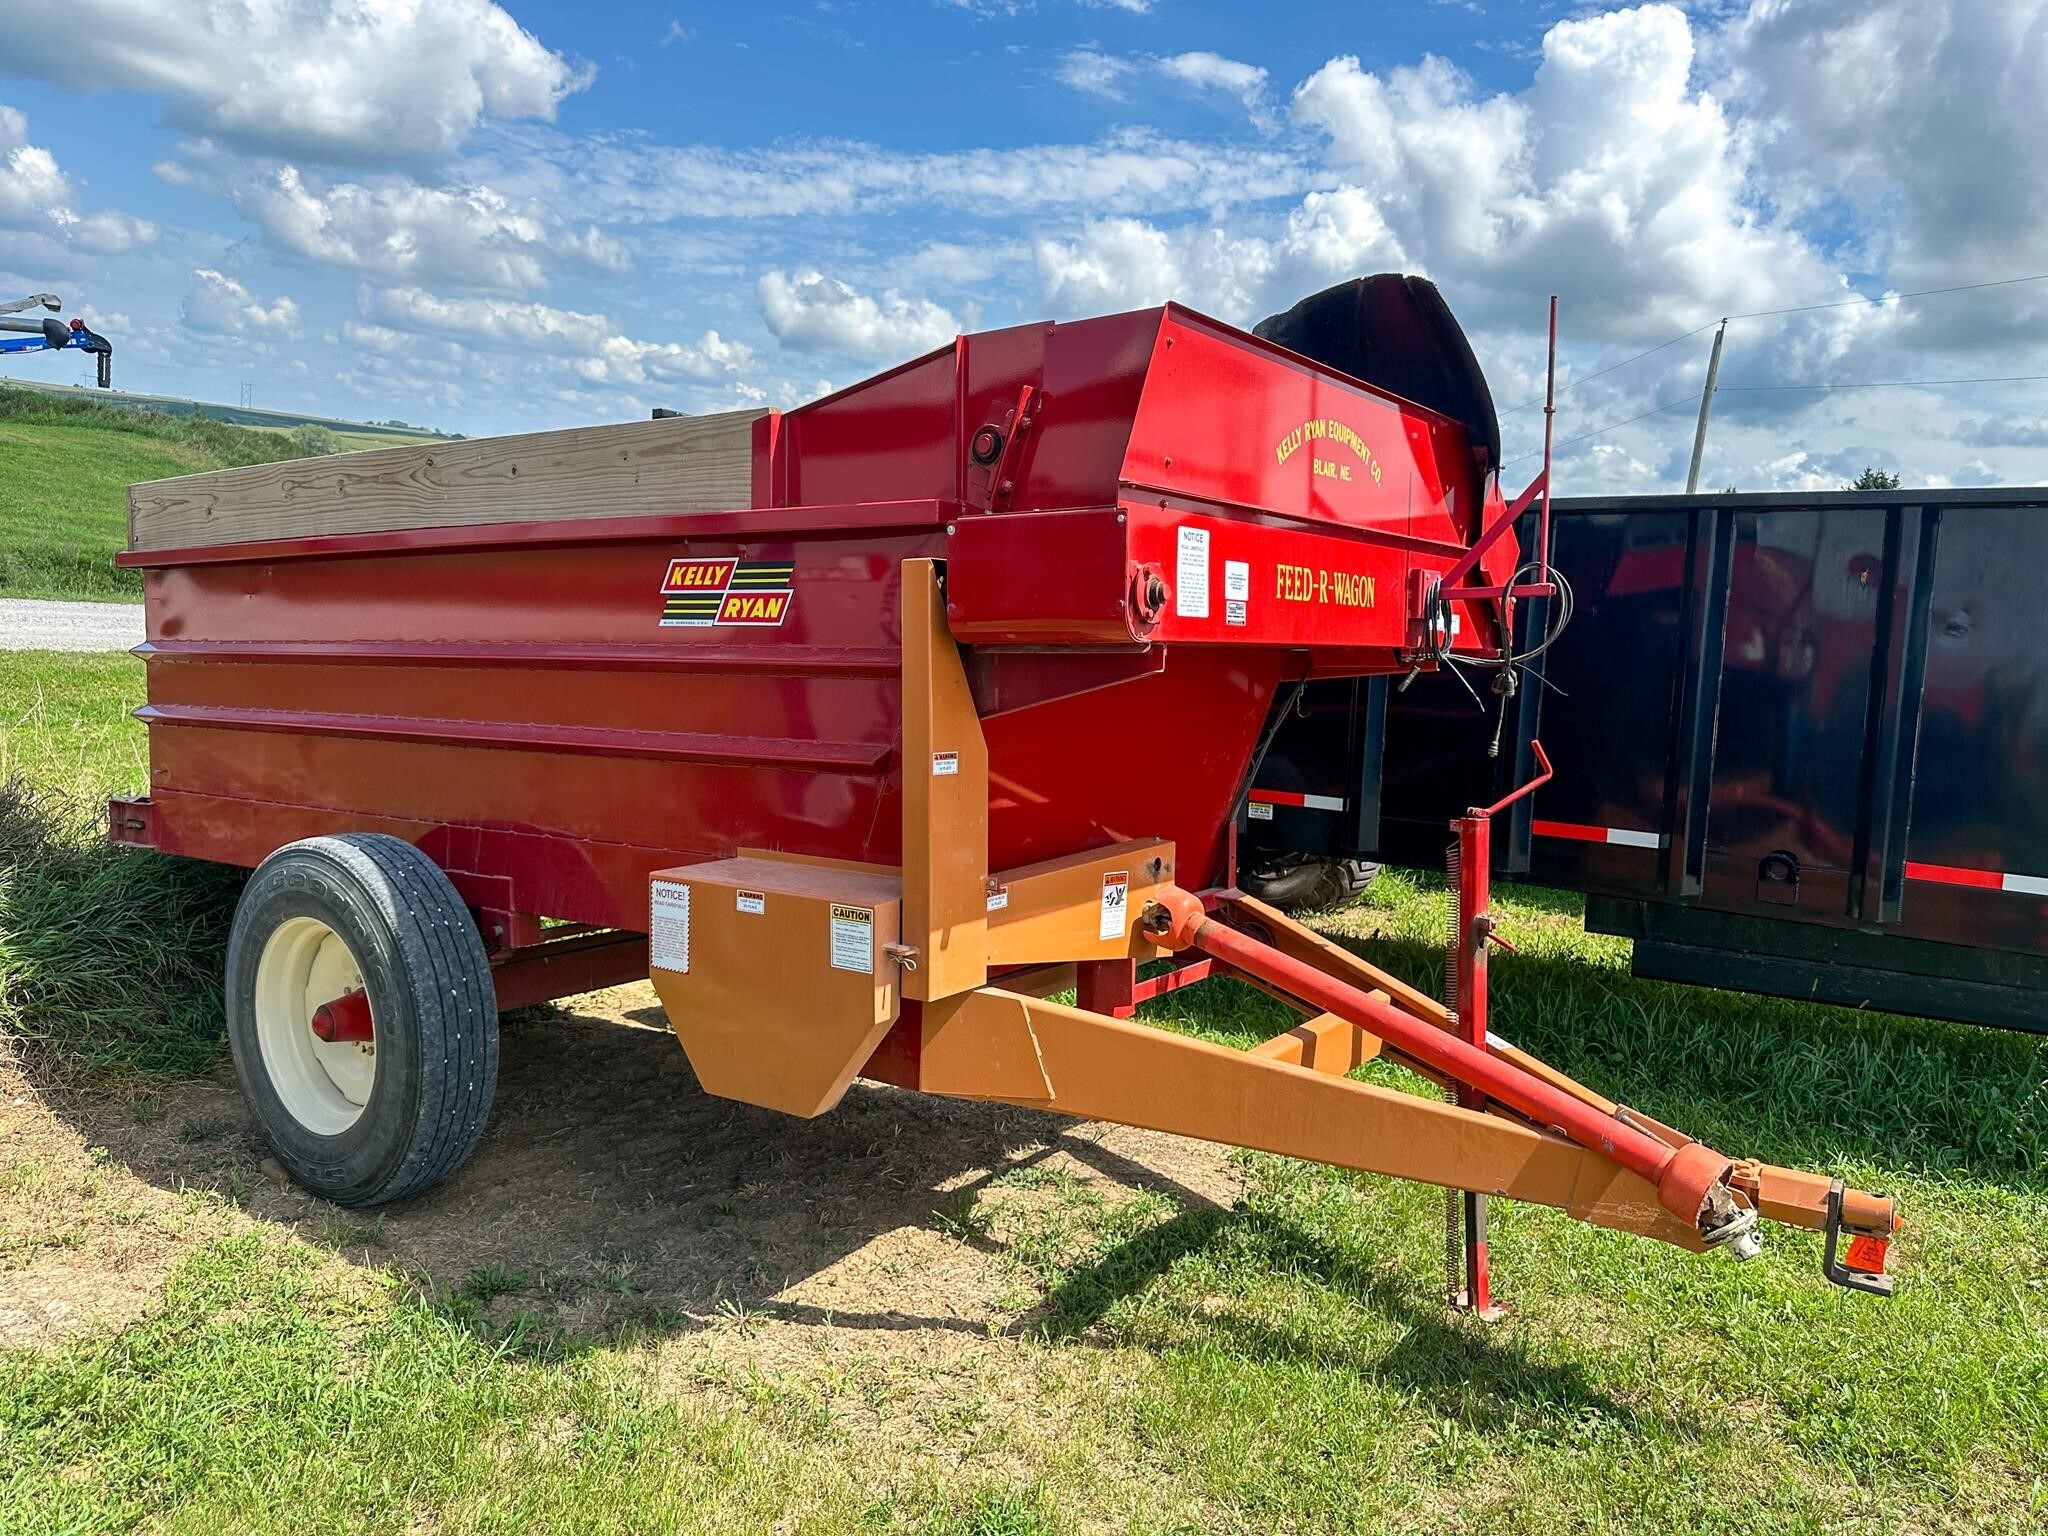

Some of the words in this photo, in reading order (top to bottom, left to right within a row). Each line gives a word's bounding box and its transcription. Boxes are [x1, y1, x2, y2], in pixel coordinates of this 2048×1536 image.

[1275, 426, 1301, 466] KELLY
[1303, 419, 1326, 442] RYAN
[1328, 419, 1372, 466] EQUIPMENT
[1370, 459, 1381, 488] CO.
[1313, 458, 1338, 481] BLAIR,
[1340, 464, 1352, 482] NE.
[1183, 531, 1204, 544] NOTICE
[669, 565, 729, 586] KELLY
[1276, 563, 1376, 608] FEED-R-WAGON
[723, 597, 784, 618] RYAN
[655, 887, 686, 901] NOTICE!
[833, 907, 870, 922] CAUTION
